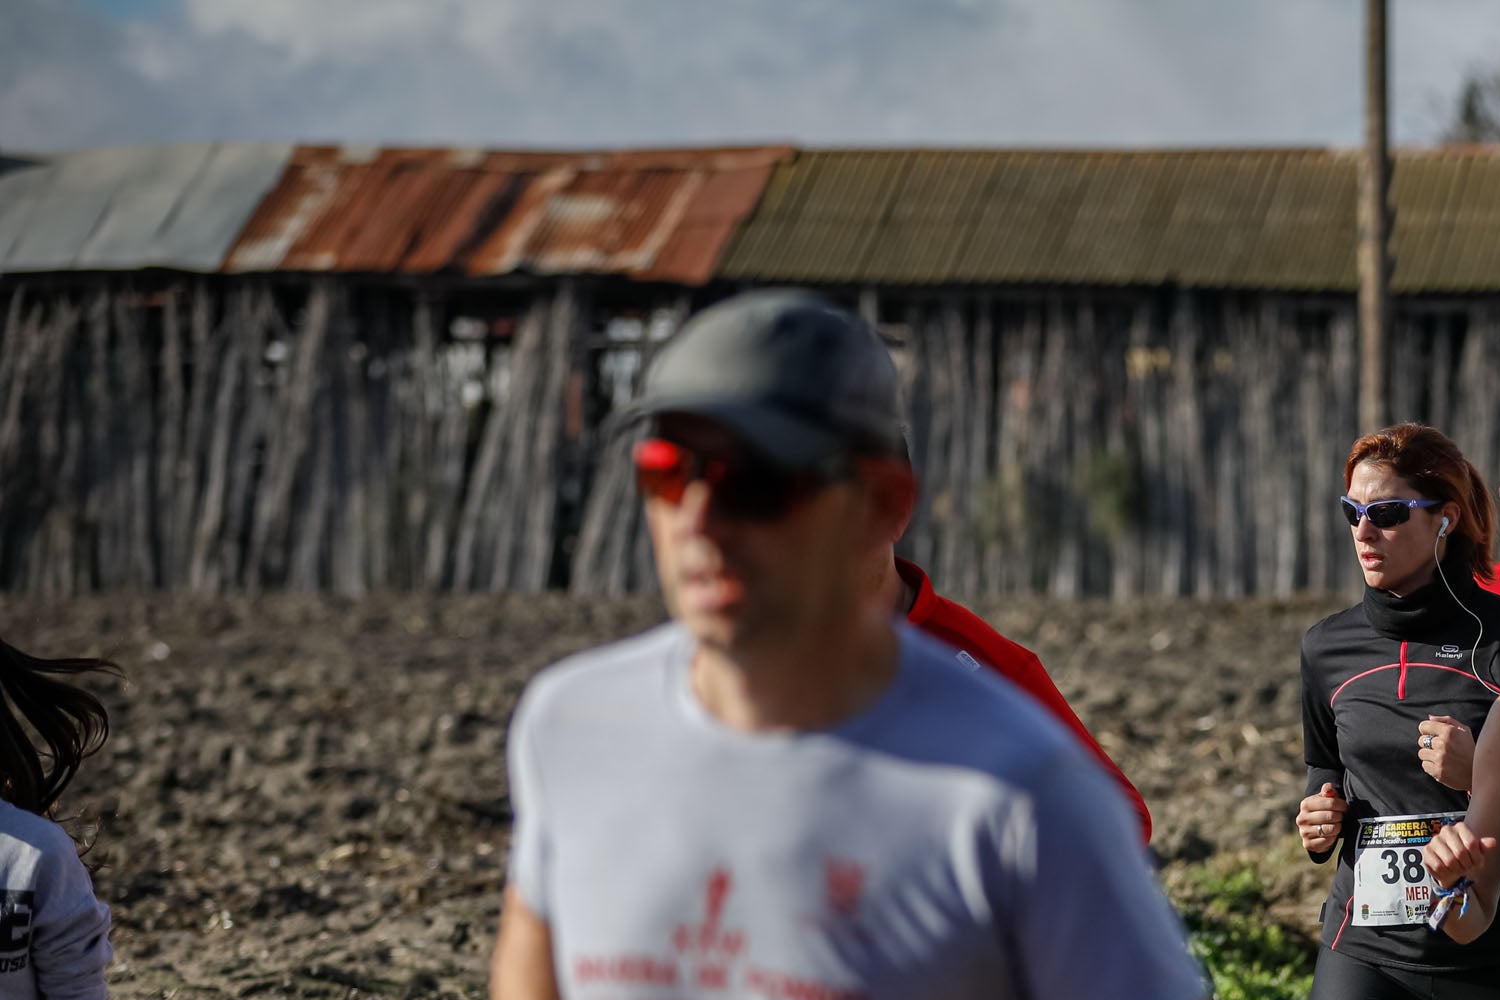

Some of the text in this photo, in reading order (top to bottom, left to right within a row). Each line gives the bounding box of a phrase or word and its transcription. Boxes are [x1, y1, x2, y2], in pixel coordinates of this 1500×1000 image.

[1435, 651, 1463, 660] Kalenji
[1385, 821, 1428, 831] CARRERA
[1385, 829, 1428, 838] POPULAR
[1405, 886, 1429, 901] MER
